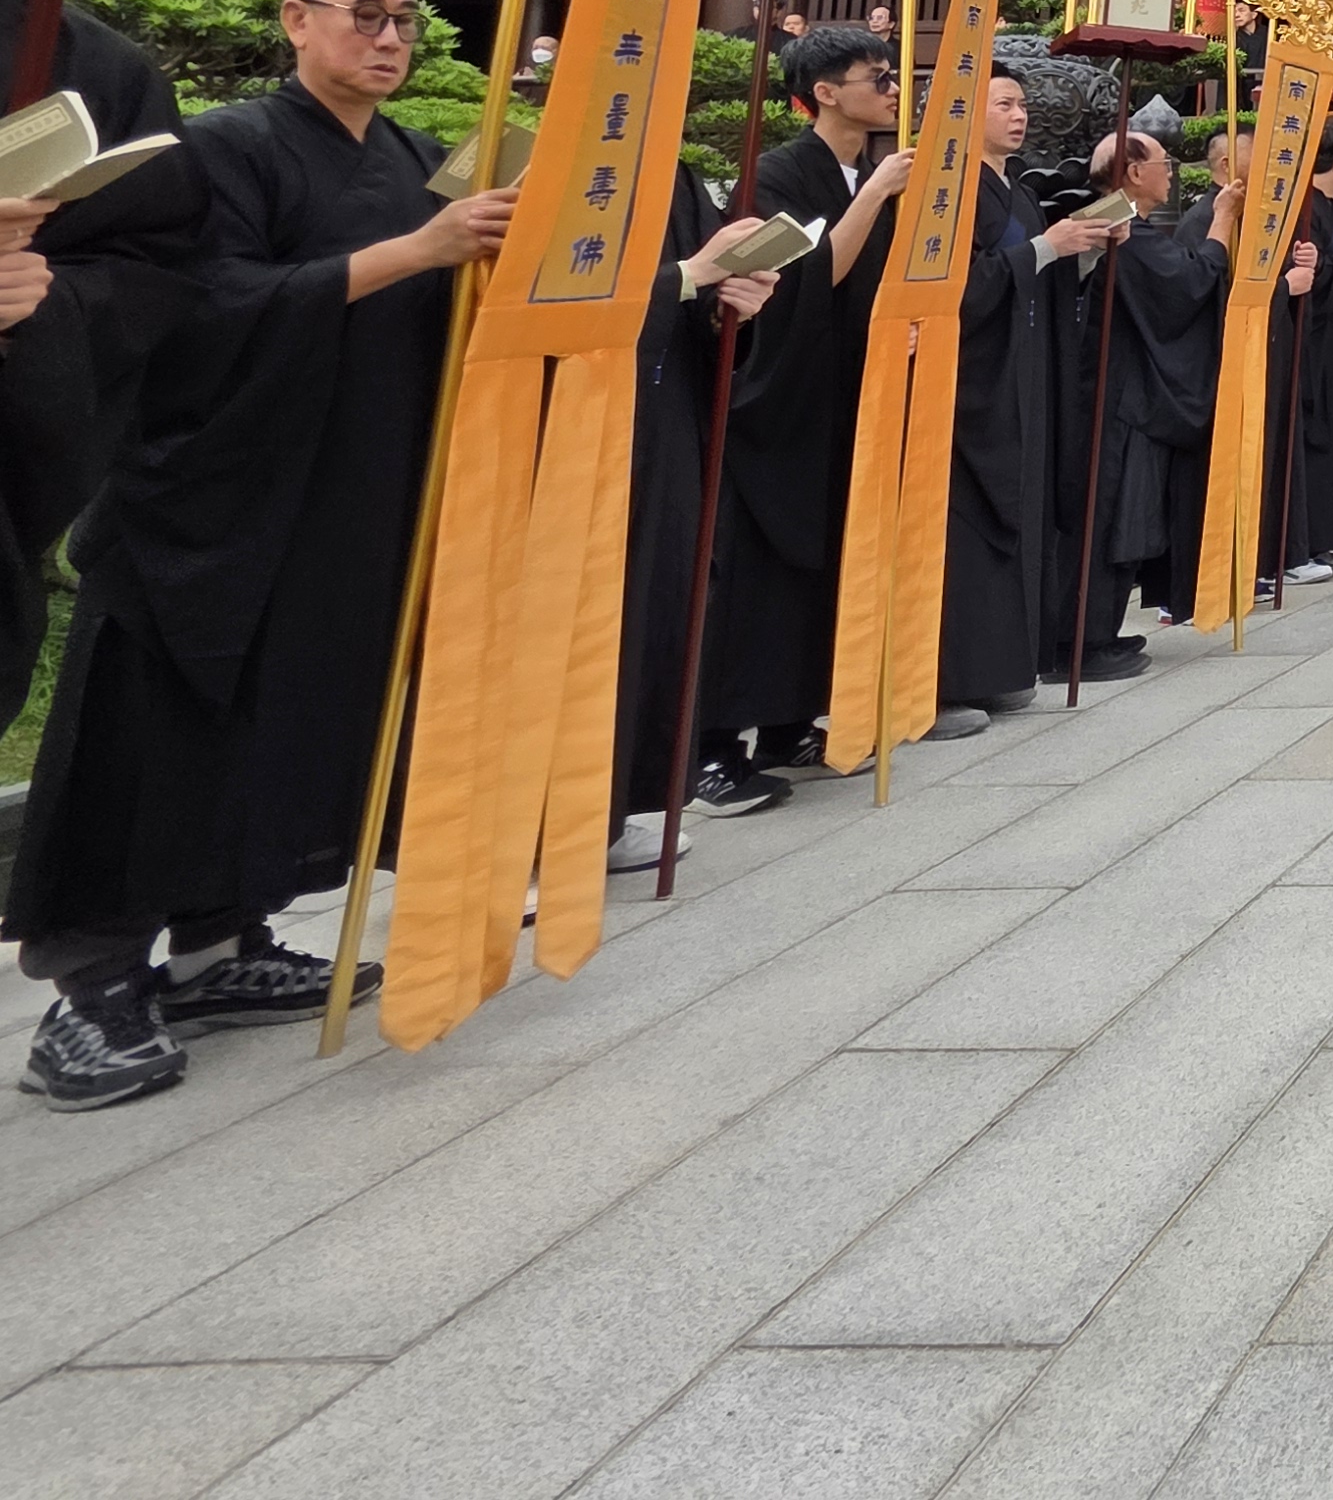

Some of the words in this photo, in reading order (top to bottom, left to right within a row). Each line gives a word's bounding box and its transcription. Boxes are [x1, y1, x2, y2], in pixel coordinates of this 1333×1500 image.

[923, 3, 982, 264] 南無無量壽佛
[1256, 79, 1308, 269] 南無無量壽佛
